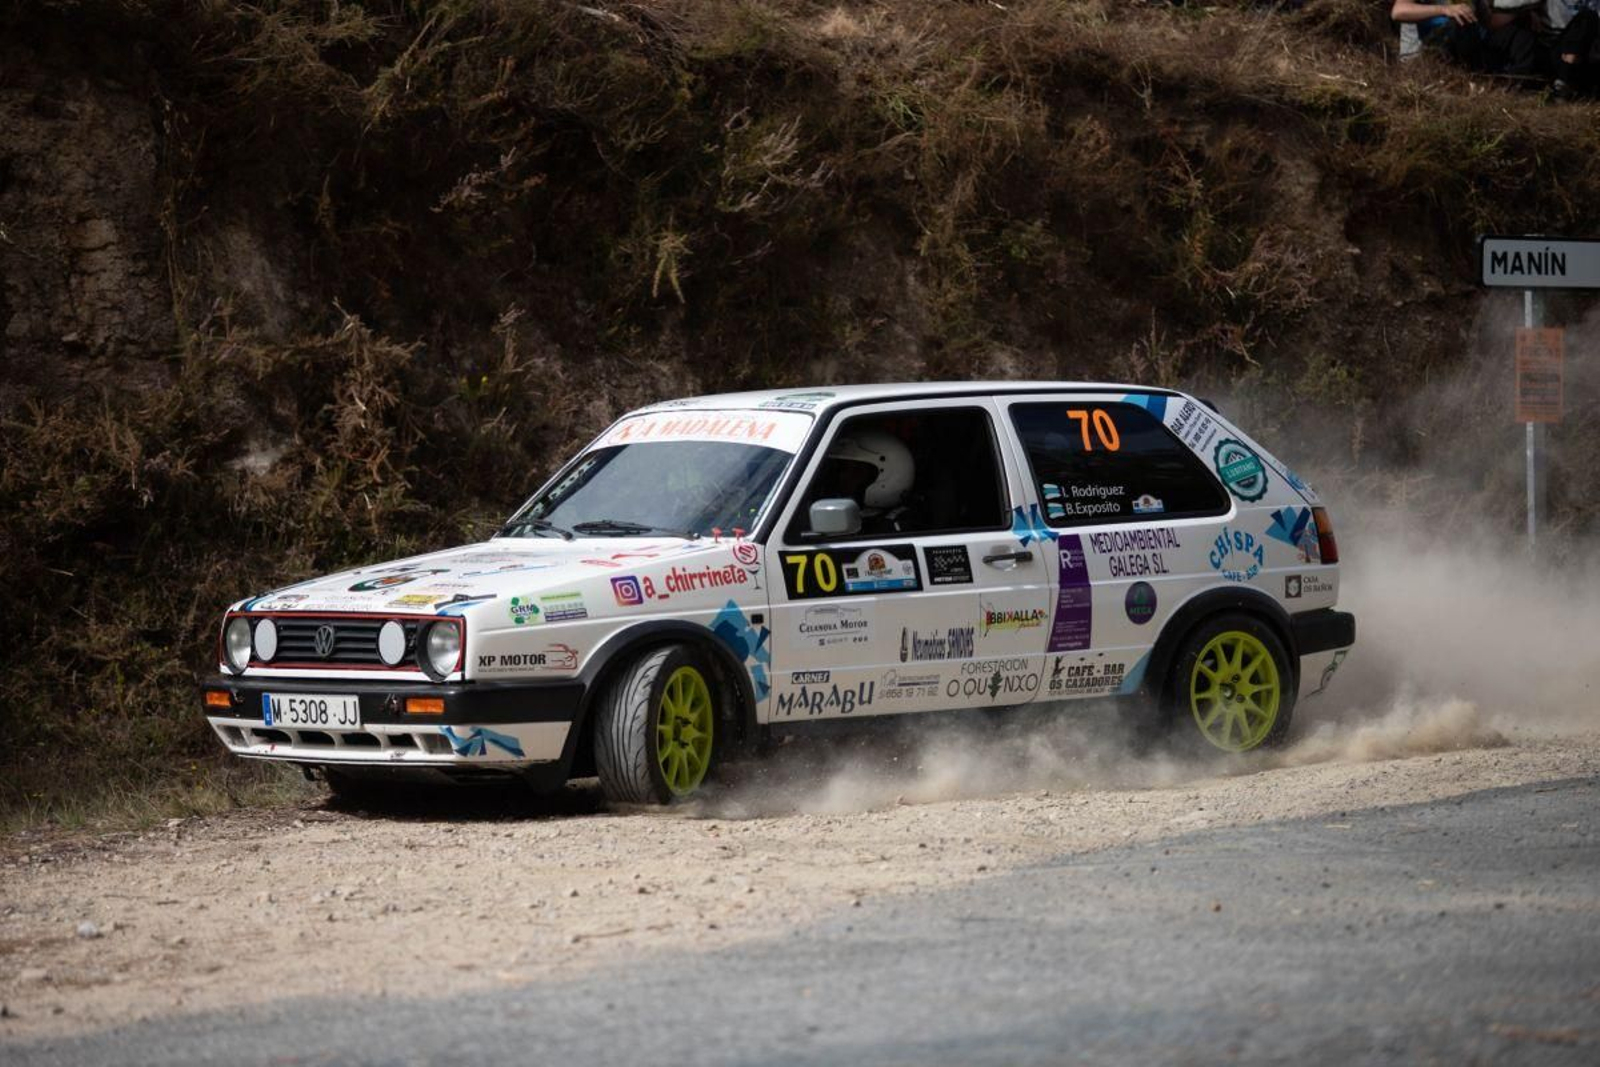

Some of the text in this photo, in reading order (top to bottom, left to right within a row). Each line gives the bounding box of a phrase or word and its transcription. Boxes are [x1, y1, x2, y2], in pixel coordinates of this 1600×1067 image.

[1490, 246, 1566, 276] MANÍN
[1066, 408, 1120, 451] 70
[1071, 485, 1125, 499] Rodriguez
[1088, 527, 1181, 554] MEDIOAMBIENTAL
[785, 552, 838, 594] 70
[1108, 553, 1151, 577] GALEGA
[478, 653, 547, 667] XP MOTOR
[1103, 663, 1125, 676] BAR
[792, 671, 830, 684] CARNES
[946, 679, 960, 697] O
[775, 681, 875, 716] MARABU
